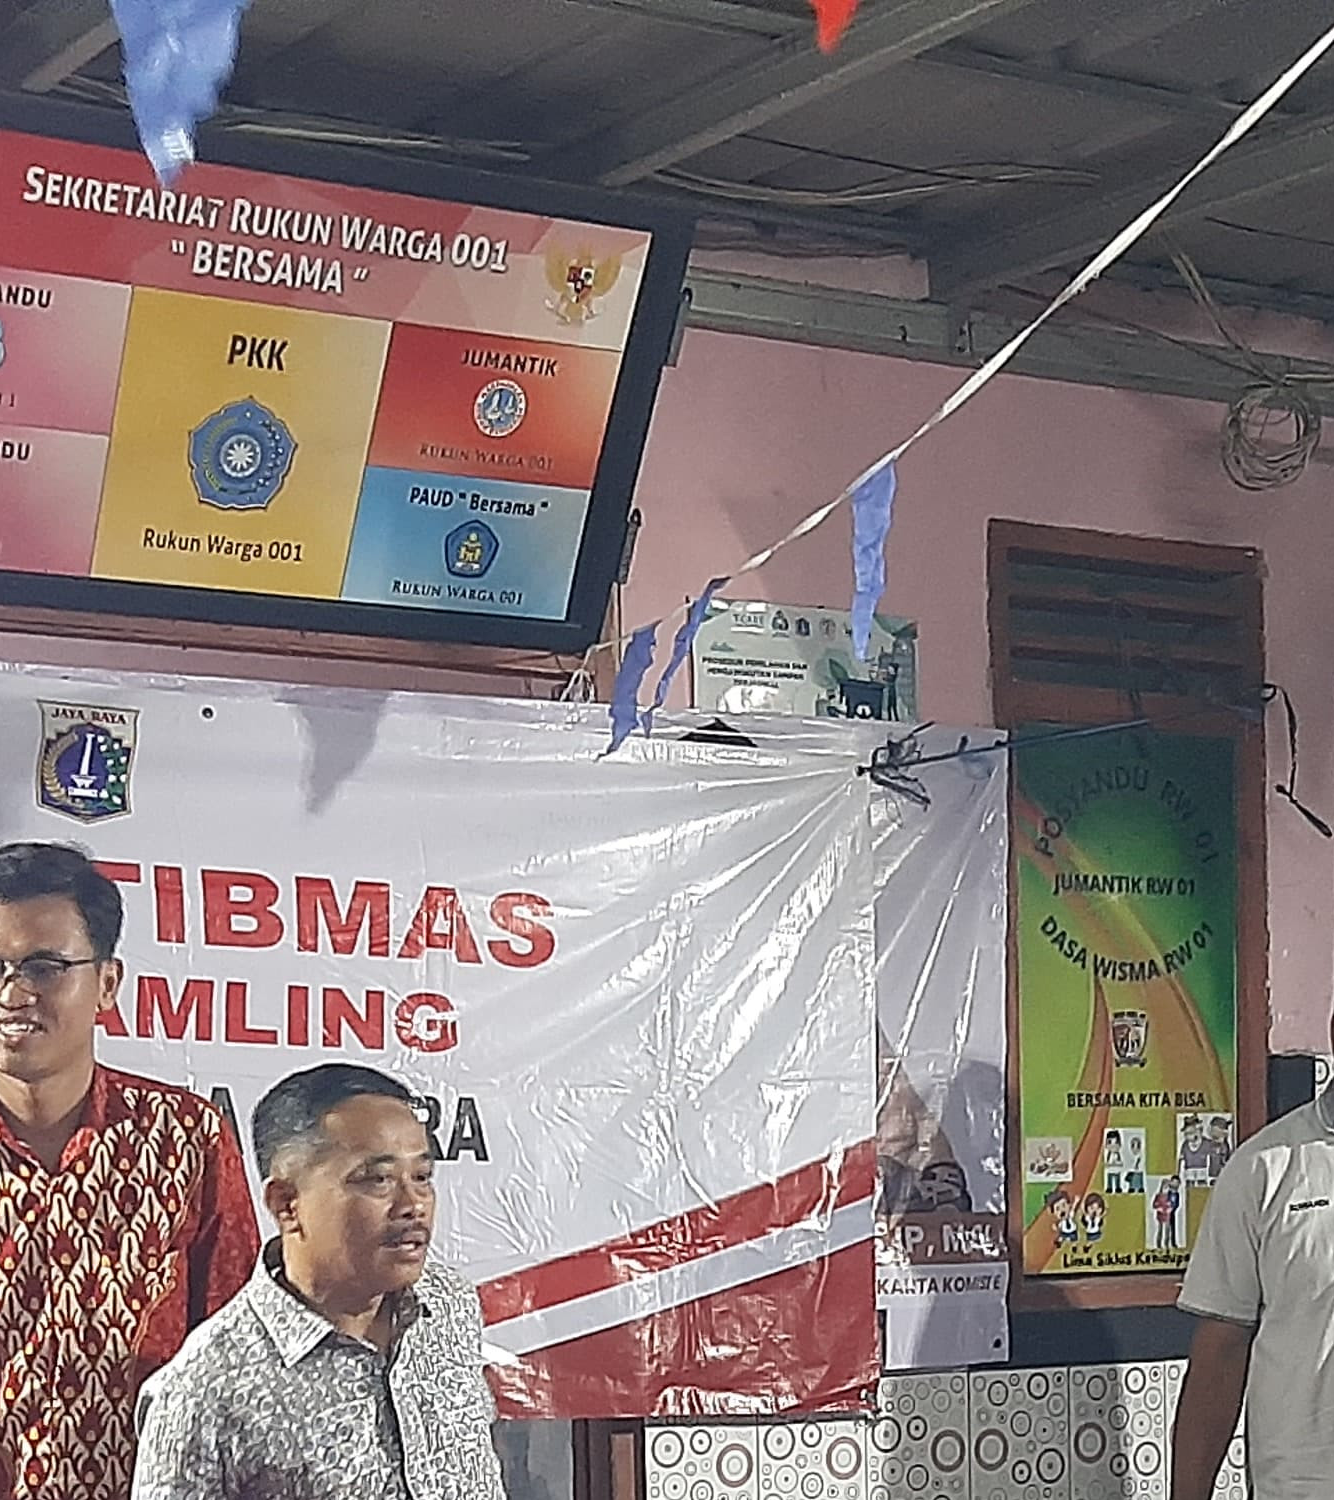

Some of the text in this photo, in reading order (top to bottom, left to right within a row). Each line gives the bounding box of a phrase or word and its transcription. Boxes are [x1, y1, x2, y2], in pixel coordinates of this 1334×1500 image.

[23, 165, 509, 273] SEKRETARIAT RUKUN WARGA 001
[192, 240, 344, 294] BERSAMA
[227, 334, 289, 372] PKK
[460, 349, 558, 377] JUMANTIK
[409, 486, 455, 508] PAUD
[469, 493, 536, 516] Bersama
[142, 527, 304, 563] Rukun Warga 001
[391, 579, 525, 606] RUKUN WARGA 001
[51, 707, 127, 725] JAYA RAYA
[1053, 873, 1196, 897] JUMANTIK RW 01
[1040, 915, 1215, 982] DASA WISMA RW 01
[1066, 1091, 1206, 1109] BERSAMA KITA BISA
